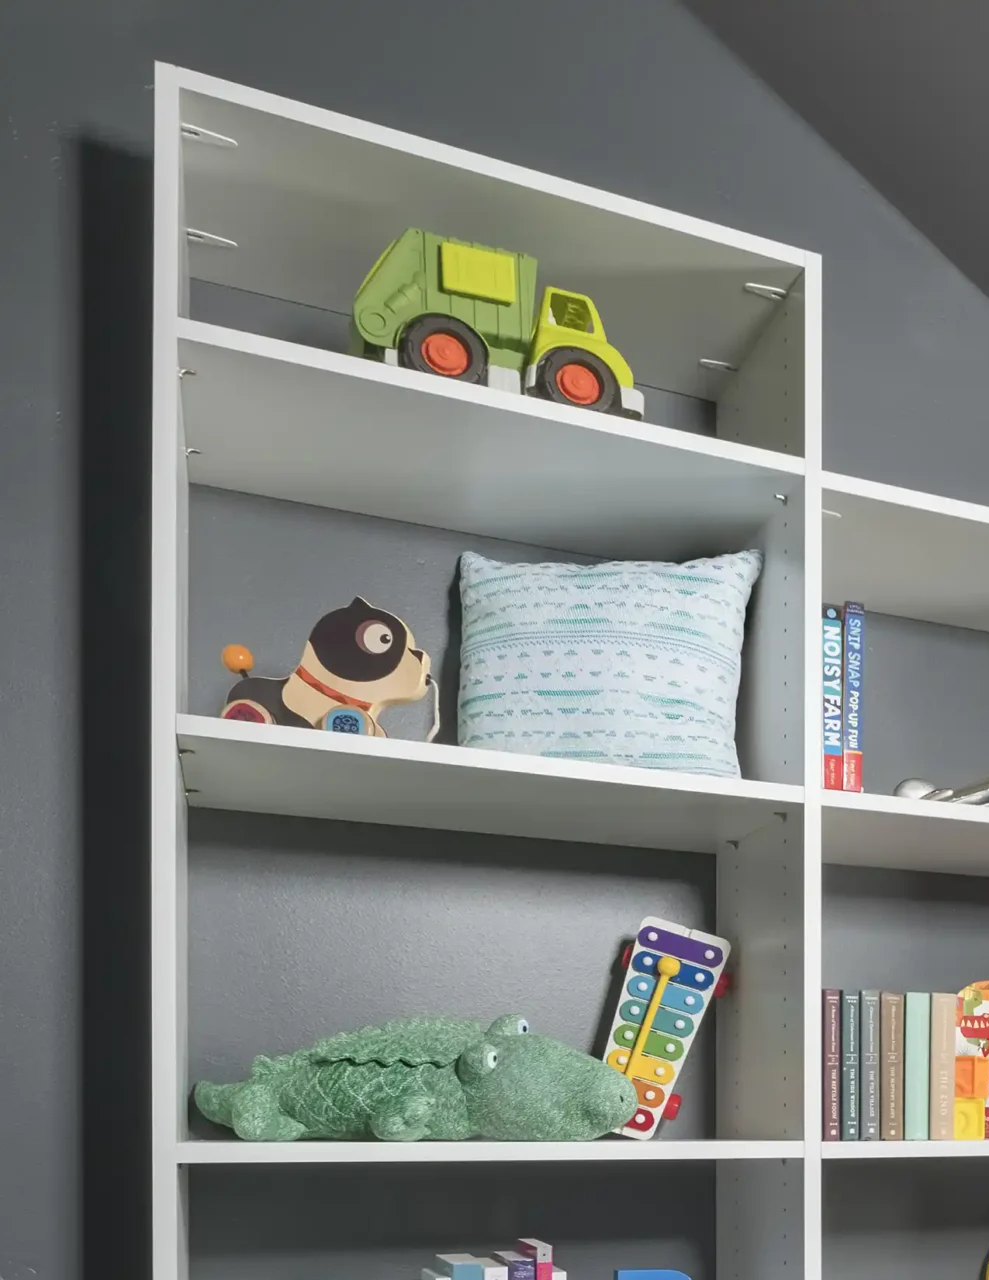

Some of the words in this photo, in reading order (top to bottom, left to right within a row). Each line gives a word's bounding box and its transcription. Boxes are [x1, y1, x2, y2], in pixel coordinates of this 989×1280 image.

[848, 618, 861, 650] SNIP
[823, 625, 842, 691] NOISY
[847, 651, 861, 688] SNAP
[823, 694, 841, 747] FARM
[847, 690, 860, 728] POP-UP
[847, 729, 859, 749] FUN
